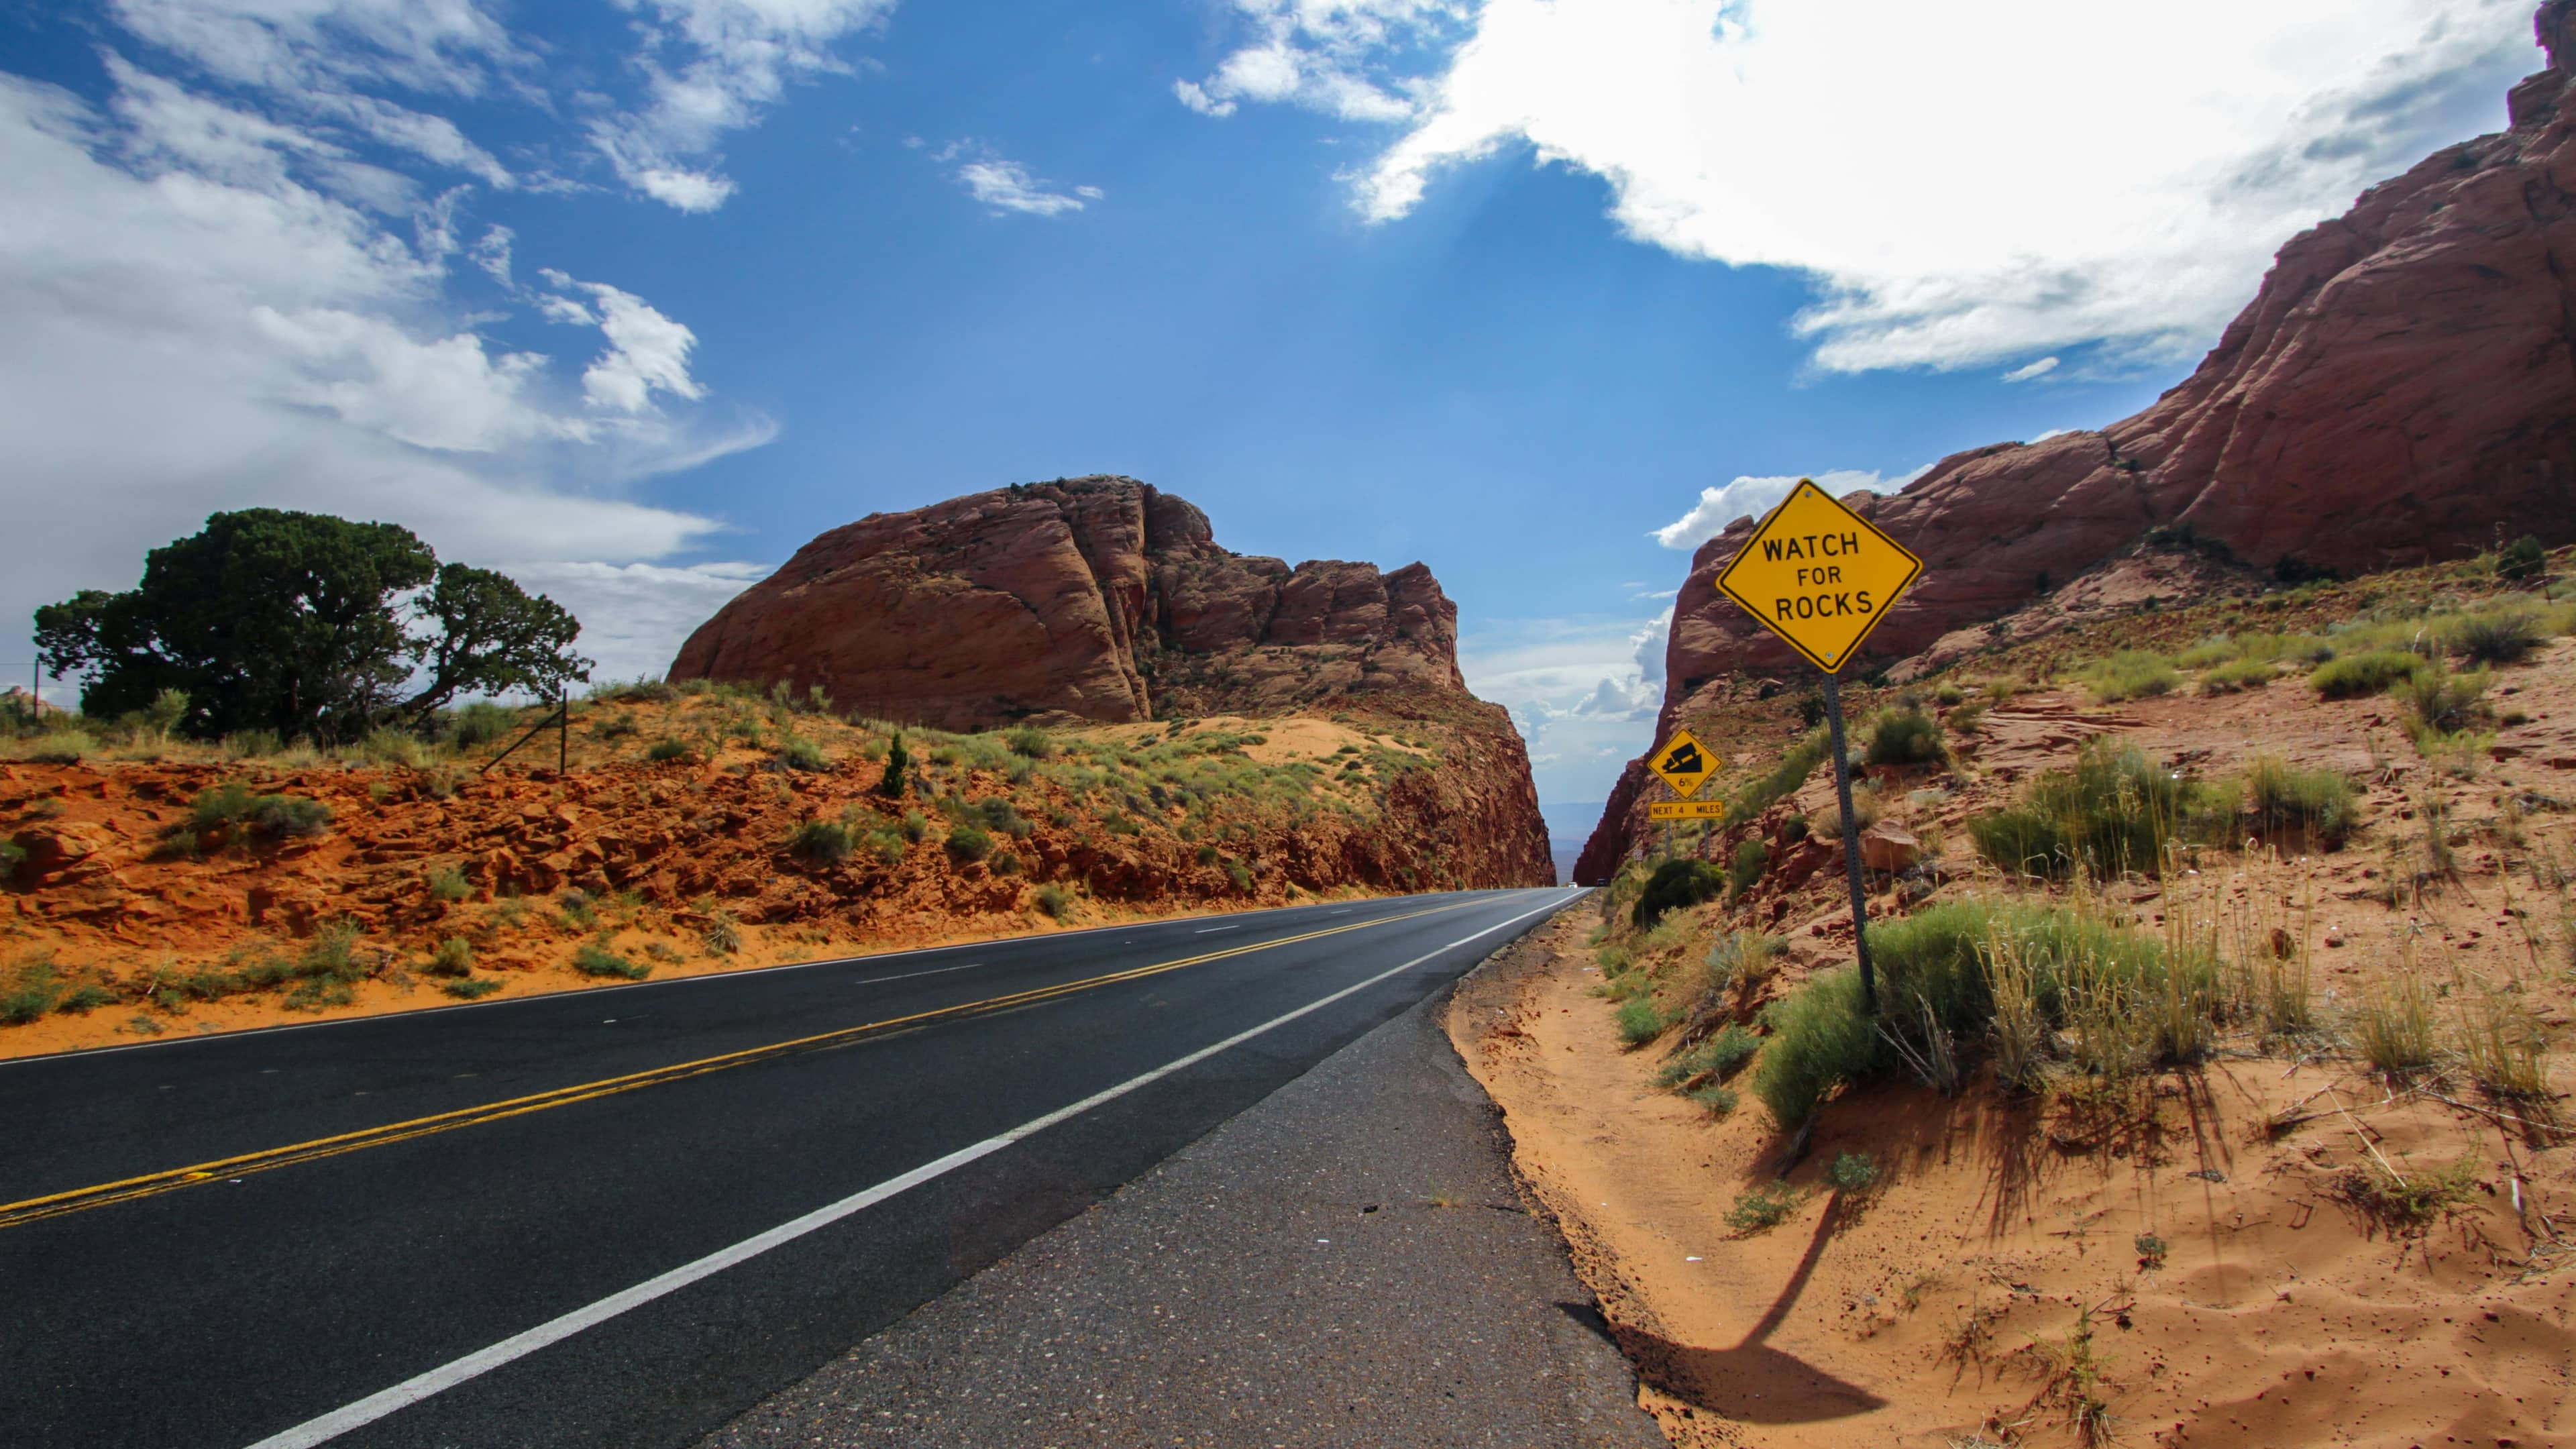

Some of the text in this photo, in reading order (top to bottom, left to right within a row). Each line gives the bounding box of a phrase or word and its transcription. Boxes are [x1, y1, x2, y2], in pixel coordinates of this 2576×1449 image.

[1762, 532, 1859, 561] WATCH
[1798, 566, 1842, 586] FOR
[1776, 591, 1872, 621] ROCKS
[1678, 778, 1693, 787] 6%
[1653, 807, 1673, 815] NEXT
[1697, 805, 1720, 813] MILES
